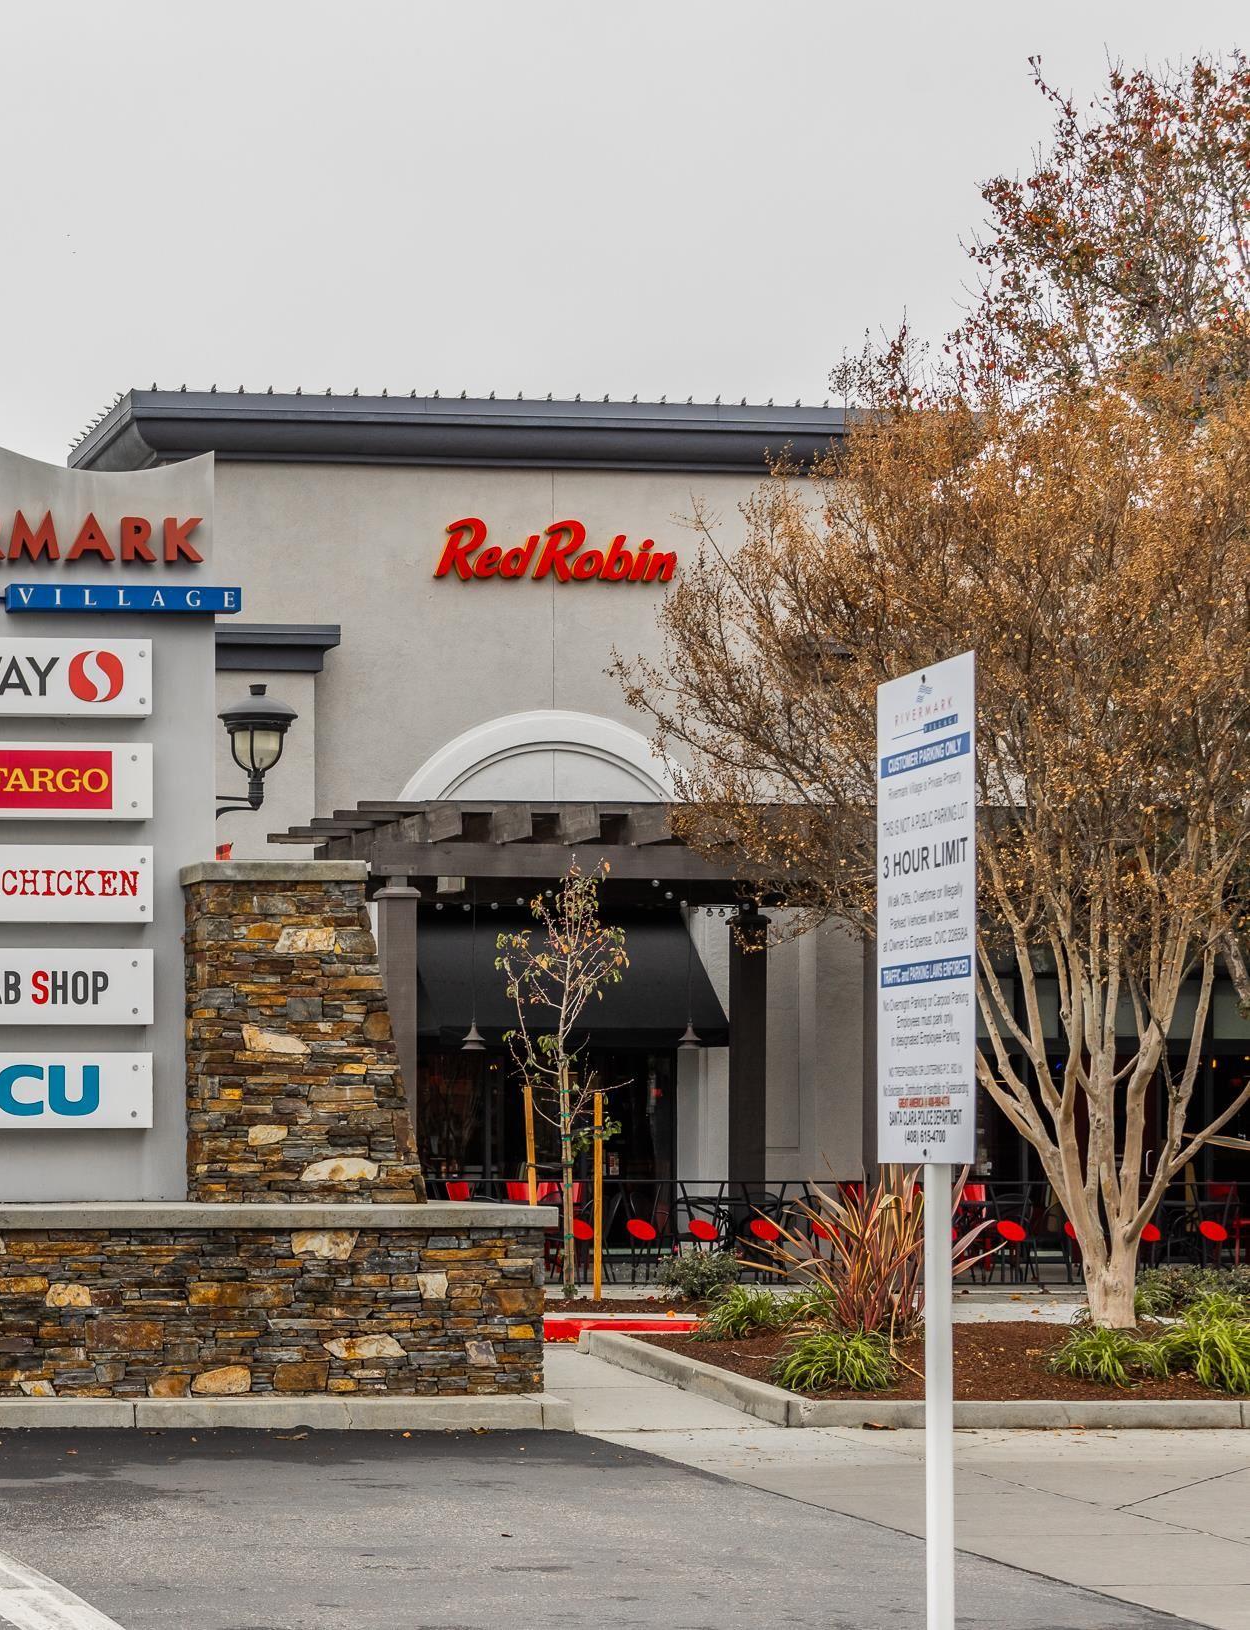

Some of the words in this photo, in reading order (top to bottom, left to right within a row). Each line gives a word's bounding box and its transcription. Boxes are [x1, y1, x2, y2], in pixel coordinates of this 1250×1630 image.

[434, 517, 541, 581] Red
[531, 520, 678, 583] Robin
[18, 587, 237, 609] VILLAGE
[887, 751, 919, 774] CUSTOMER
[919, 742, 945, 763] PARKING
[945, 737, 962, 756] ONLY
[883, 854, 890, 880] 3
[893, 846, 932, 877] HOUR
[934, 836, 969, 869] LIMIT
[1, 870, 140, 896] CHICKEN
[909, 964, 930, 982] PARKING
[943, 958, 969, 977] ENFORCED
[31, 970, 110, 1005] SHOP
[889, 1111, 903, 1126] SANTA
[903, 1110, 917, 1126] CLARA
[917, 1110, 934, 1126] POLICE
[933, 1109, 963, 1126] DEPARTMENT
[904, 1130, 919, 1146] (408)
[920, 1129, 947, 1144] 615-4700
